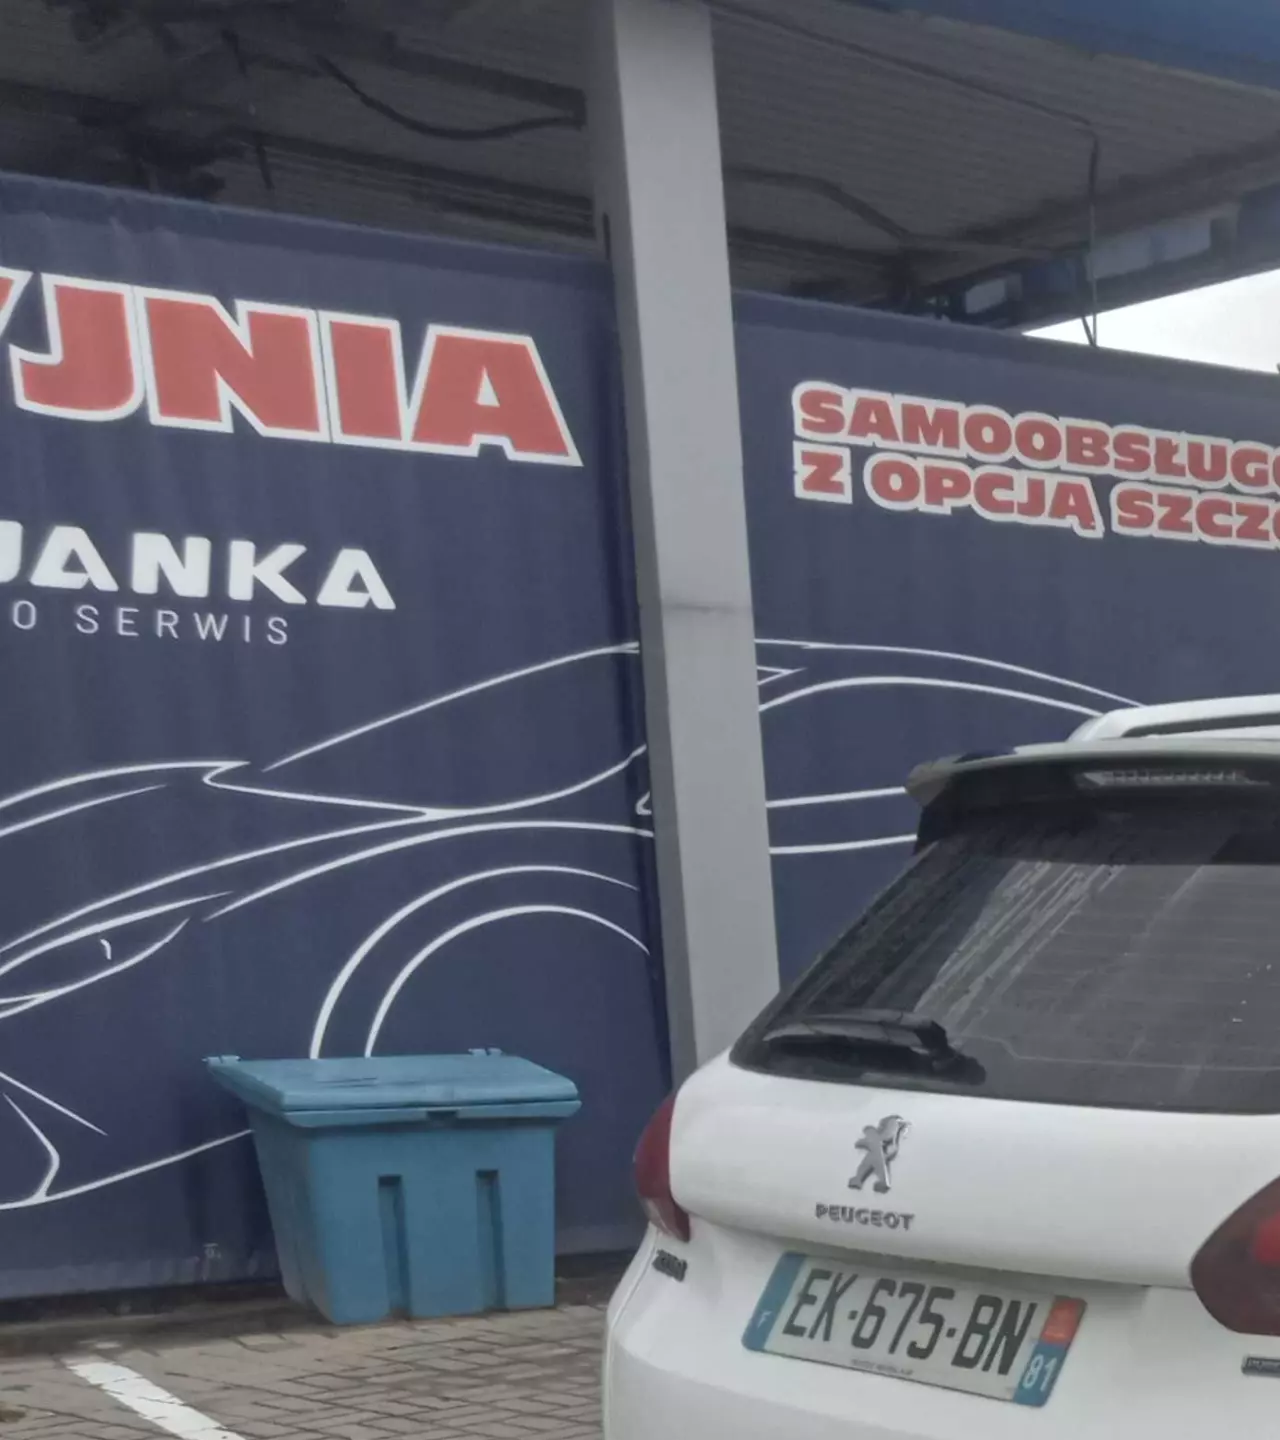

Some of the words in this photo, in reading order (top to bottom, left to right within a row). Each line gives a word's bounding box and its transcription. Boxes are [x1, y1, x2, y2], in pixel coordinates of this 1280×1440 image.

[793, 440, 853, 504] Z
[863, 452, 1105, 539] OPCJĄ
[75, 604, 289, 645] SERWIS
[814, 1202, 916, 1231] PEUGEOT
[782, 1267, 1038, 1376] EK-675-BN
[1021, 1353, 1058, 1393] 81
